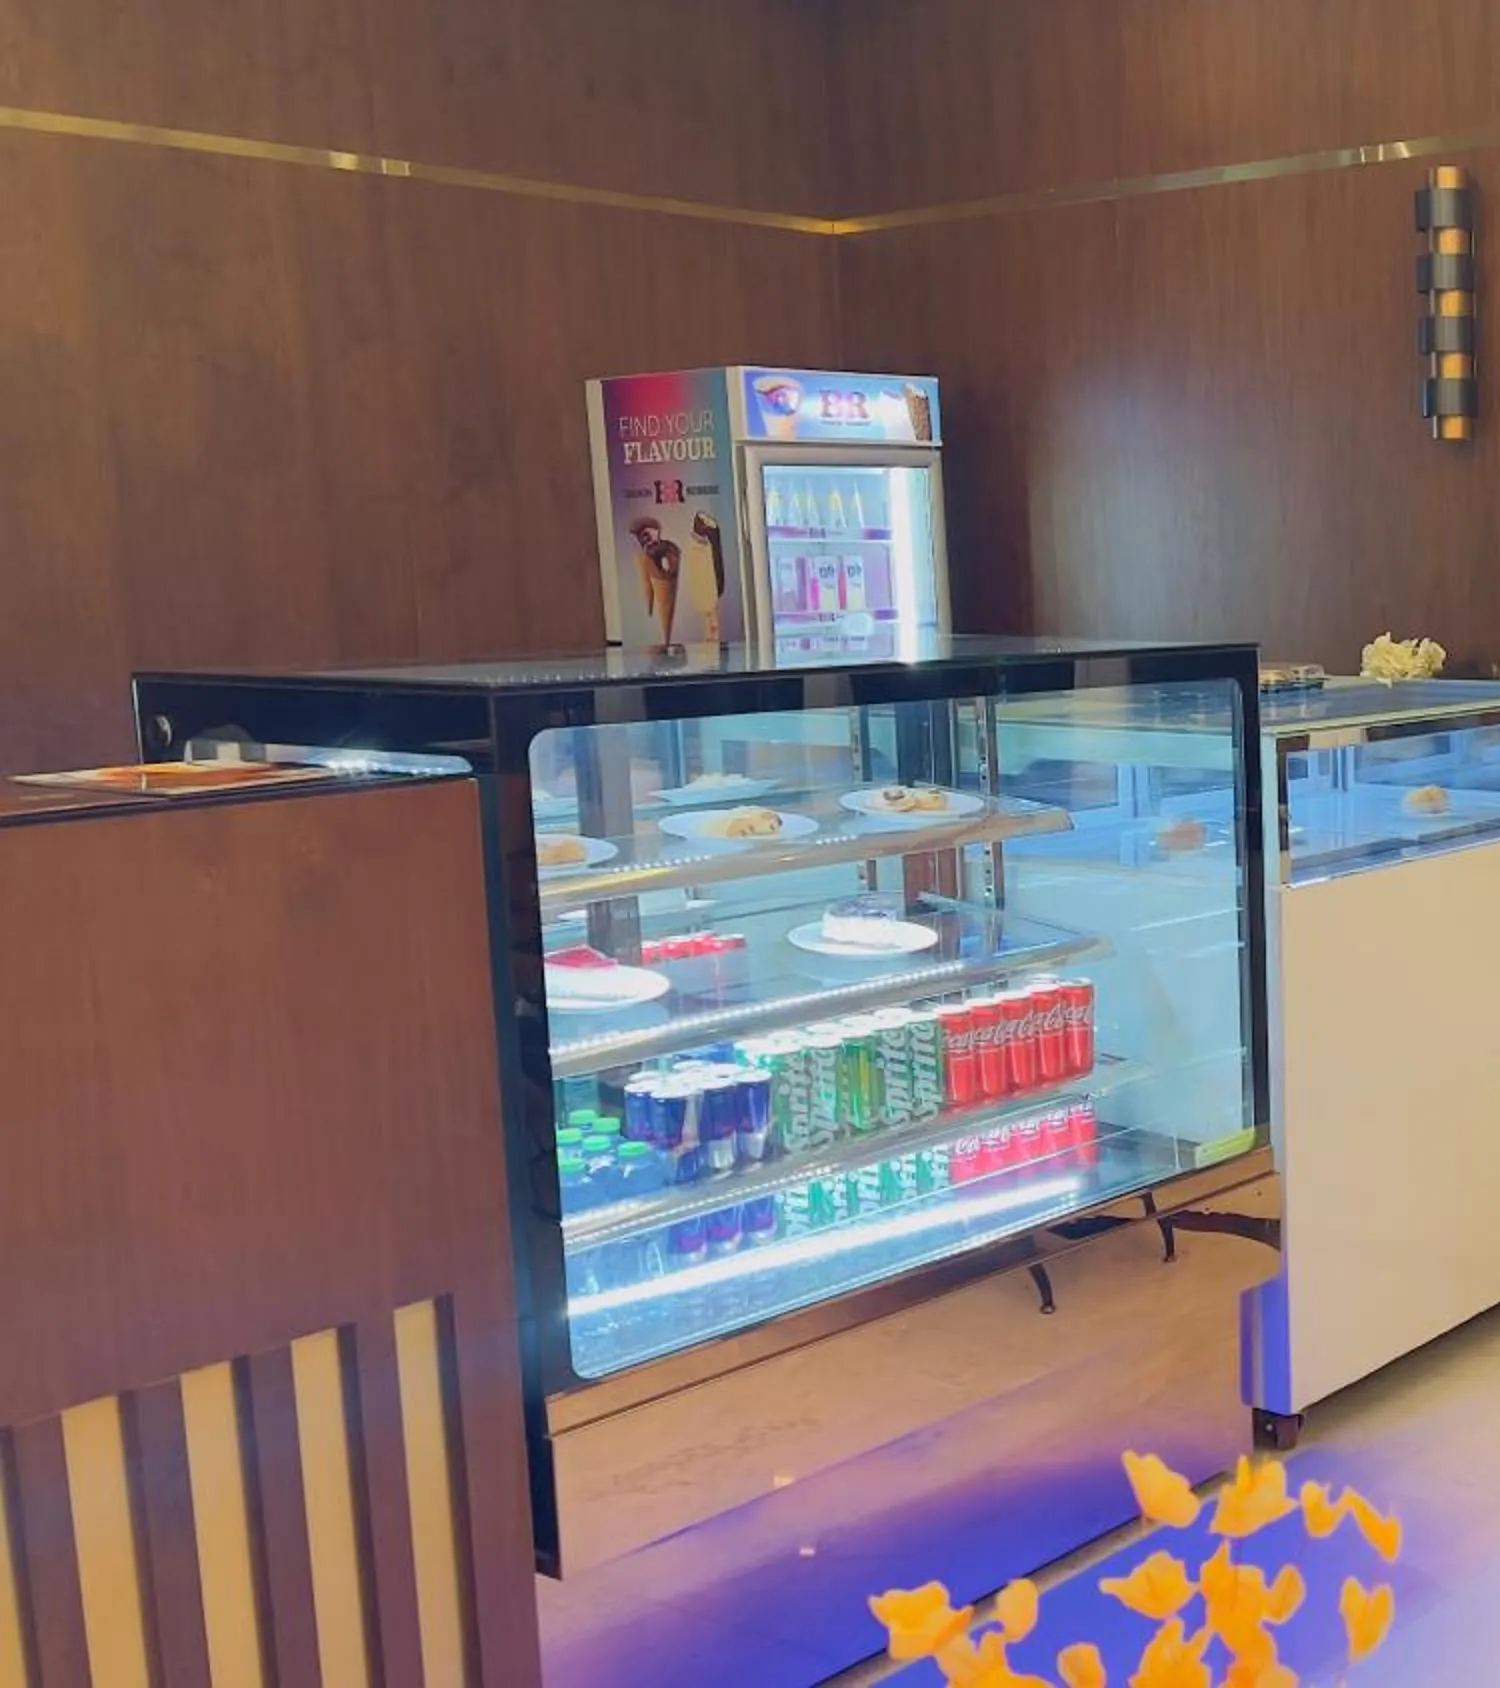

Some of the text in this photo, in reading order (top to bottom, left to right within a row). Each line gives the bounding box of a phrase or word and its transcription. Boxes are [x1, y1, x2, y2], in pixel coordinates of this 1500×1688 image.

[618, 410, 715, 438] FIND YOUR
[623, 437, 718, 465] FLAVOUR
[877, 1030, 911, 1127] Sprite
[908, 1022, 942, 1121] Sprite
